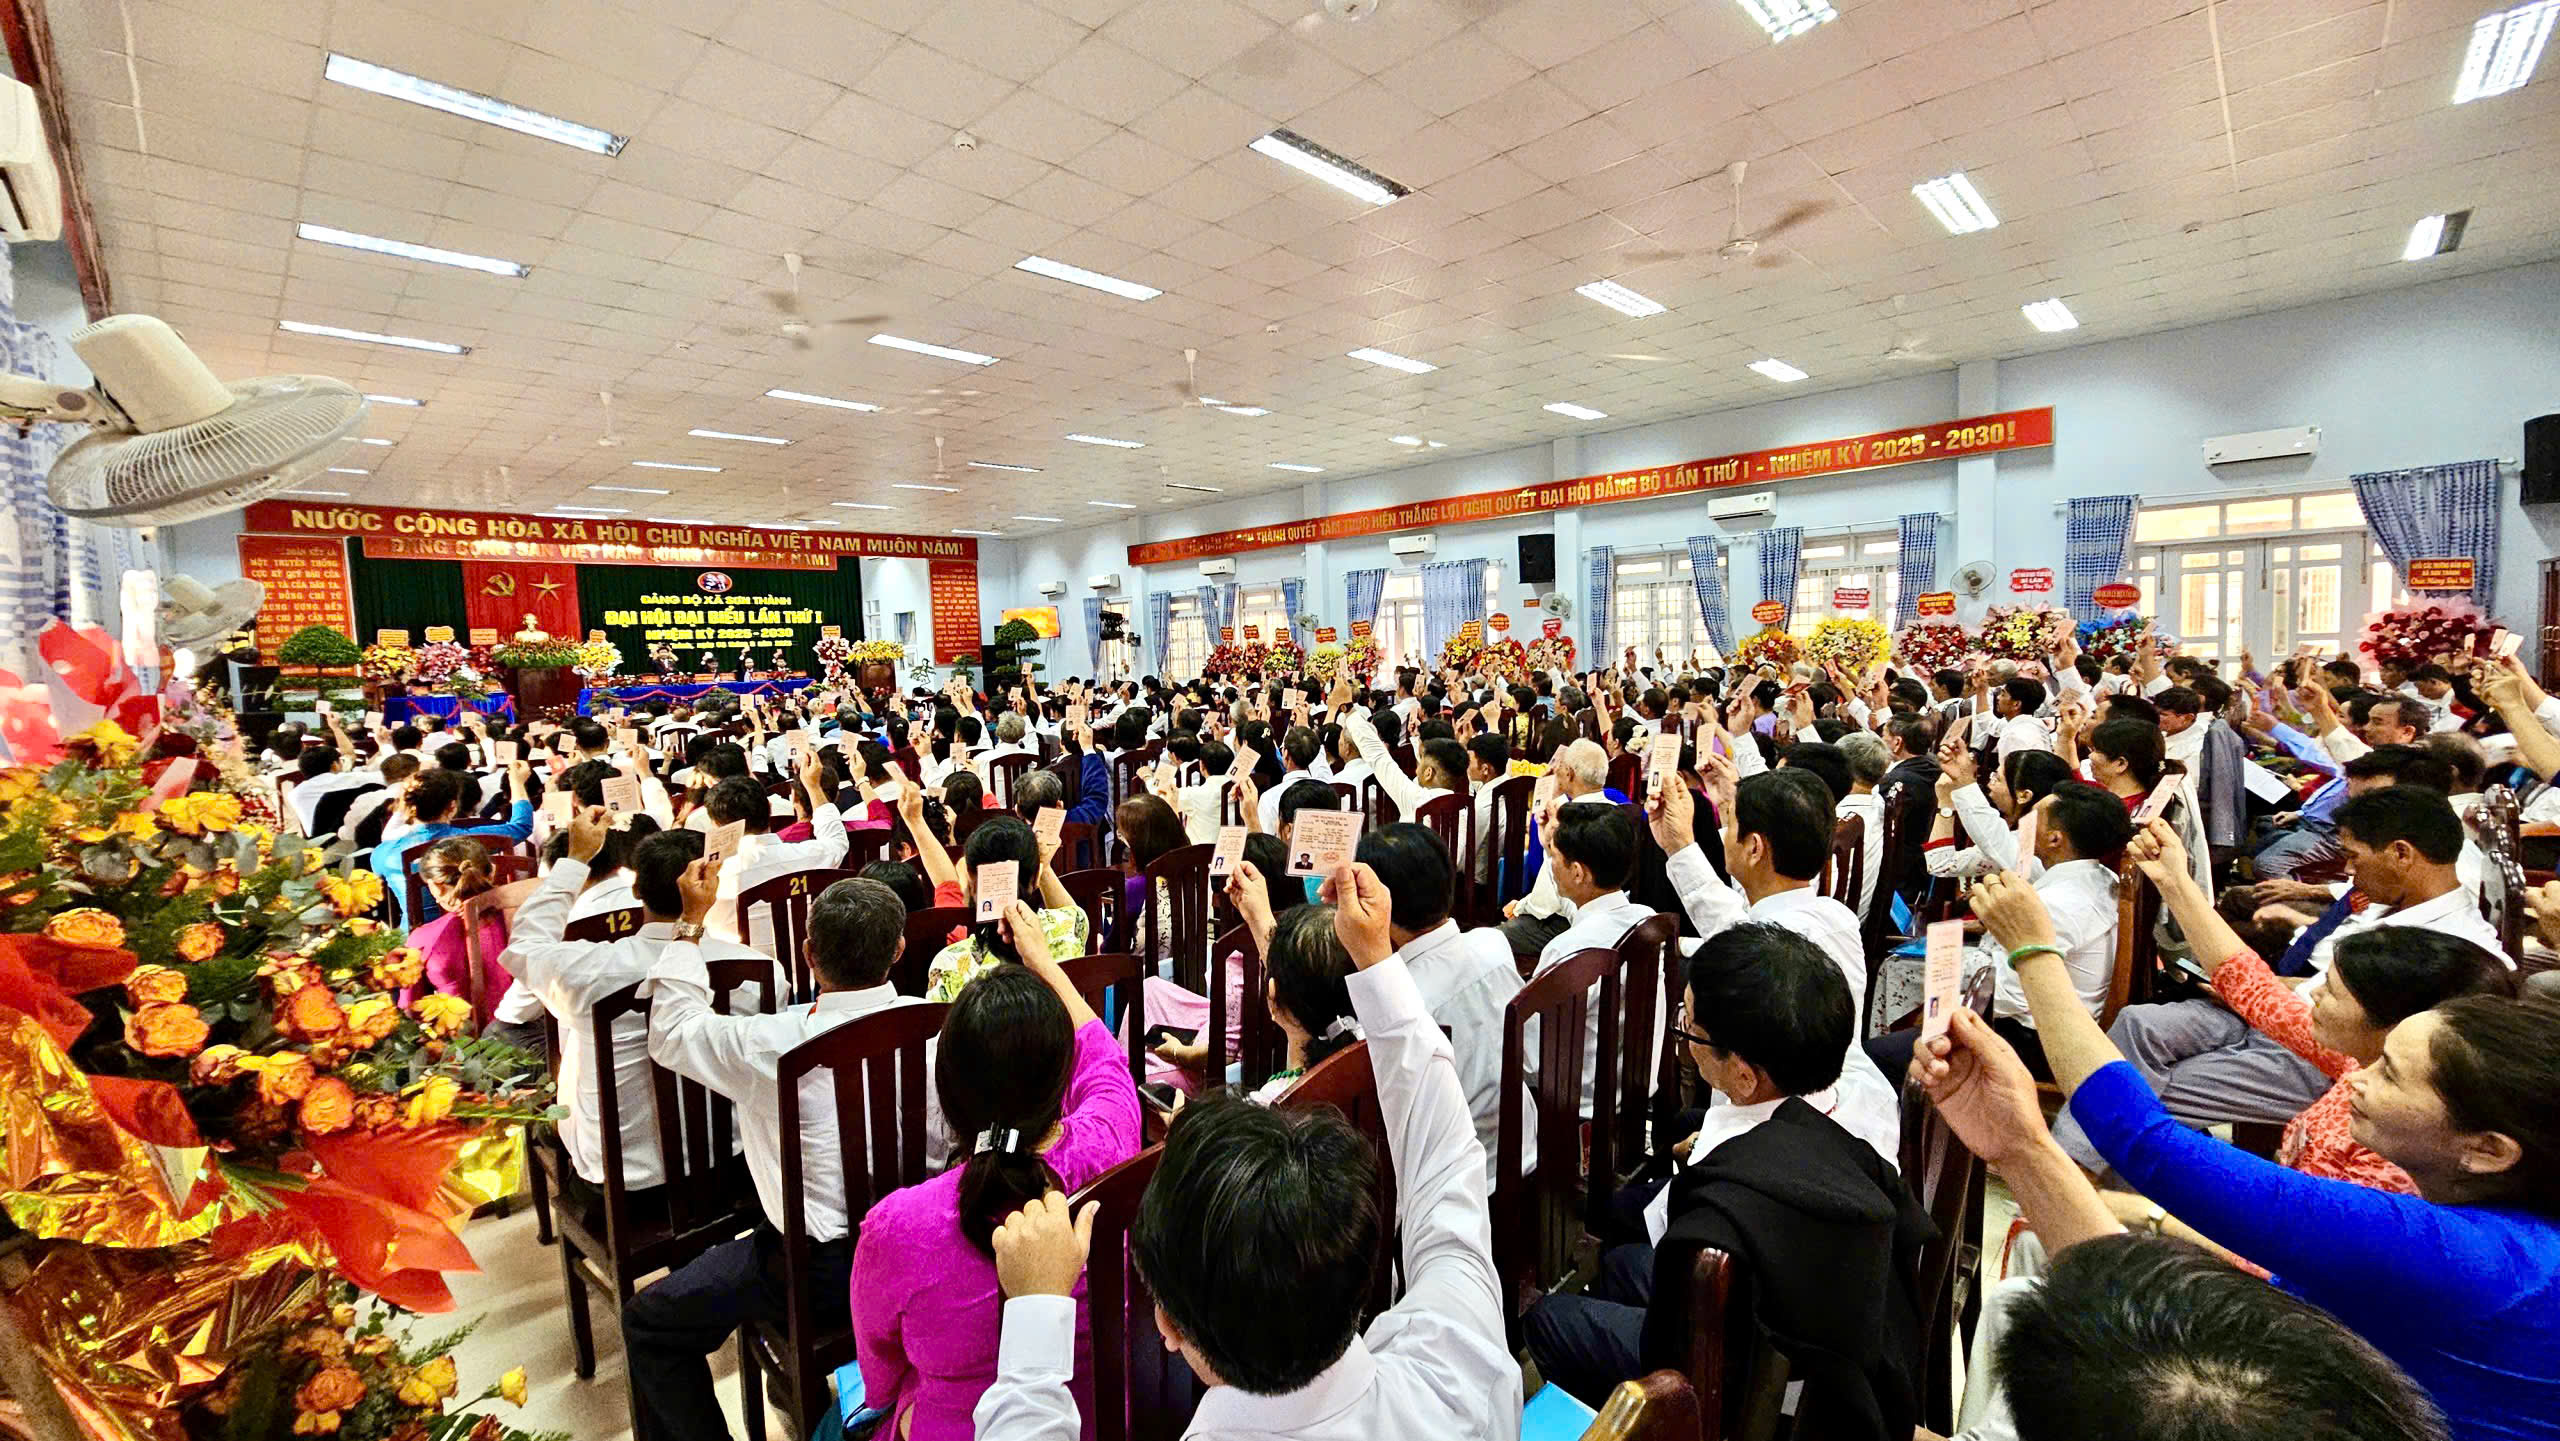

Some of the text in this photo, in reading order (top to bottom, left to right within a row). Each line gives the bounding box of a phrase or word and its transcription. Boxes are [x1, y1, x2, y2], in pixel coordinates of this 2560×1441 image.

[1288, 522, 1316, 540] QUYẾT
[1372, 511, 1396, 529] HIỆN
[1399, 504, 1437, 524] THẮNG
[1495, 488, 1536, 514] QUYẾT
[1540, 488, 1564, 508] ĐẠI
[1567, 481, 1591, 504] HỘI
[1594, 475, 1636, 499] ĐẢNG
[1639, 471, 1660, 494] BỘ
[1703, 459, 1739, 483] THỨ
[1743, 461, 1749, 478] I
[1769, 448, 1832, 474] NHIỆM
[1837, 440, 1864, 465] KỲ
[1871, 434, 1925, 460] 2025
[291, 508, 963, 555] NƯỚC CỘNG HÒA XÃ HỘI CHỦ NGHĨA VIỆT NAM MUÔN NĂM!
[640, 592, 680, 604] ĐẢNG
[682, 594, 702, 606] BỘ
[703, 594, 724, 604] XÃ
[752, 594, 792, 605] THÀNH
[604, 610, 638, 628] ĐẠI
[640, 607, 672, 627] HỘI
[674, 610, 705, 627] ĐẠI
[707, 605, 745, 625] BIỂU
[782, 608, 813, 624] THỨ
[814, 610, 822, 624] I
[695, 627, 715, 639] KỲ
[717, 628, 752, 639] 2025
[760, 627, 794, 639] 2030
[790, 875, 808, 895] 21
[606, 911, 632, 933] 12
